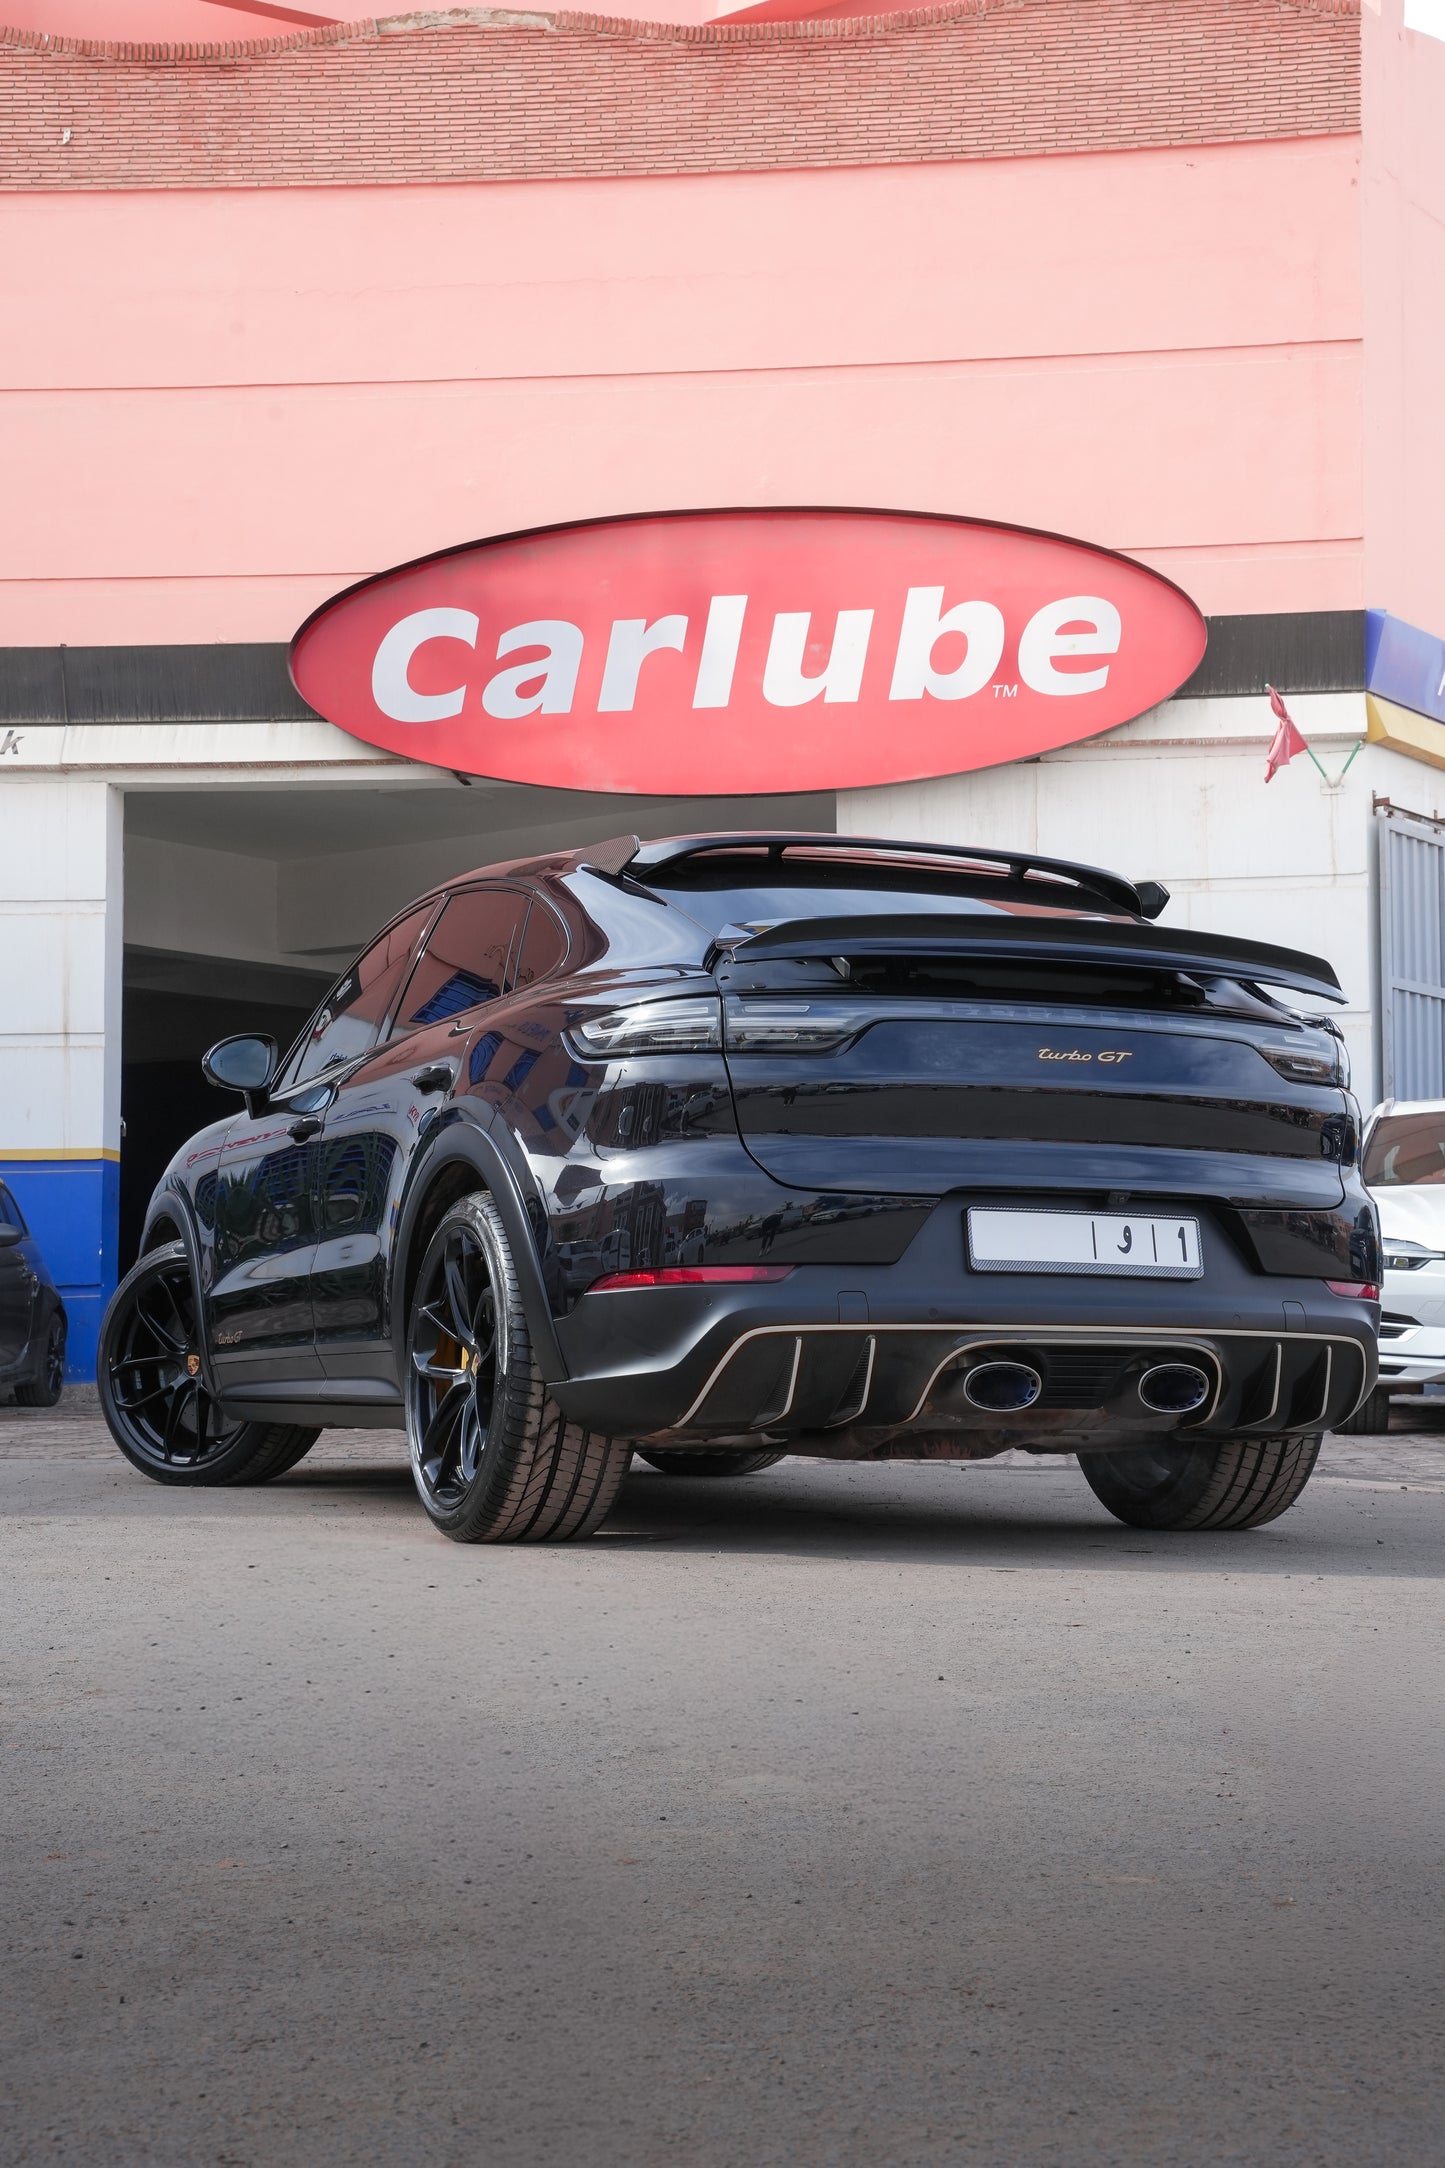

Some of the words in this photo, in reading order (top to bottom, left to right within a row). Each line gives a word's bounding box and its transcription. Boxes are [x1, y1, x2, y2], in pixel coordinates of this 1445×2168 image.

[371, 585, 1122, 723] Carlube
[992, 684, 1018, 698] TM
[1038, 1047, 1092, 1061] turbo
[1097, 1051, 1133, 1063] GT
